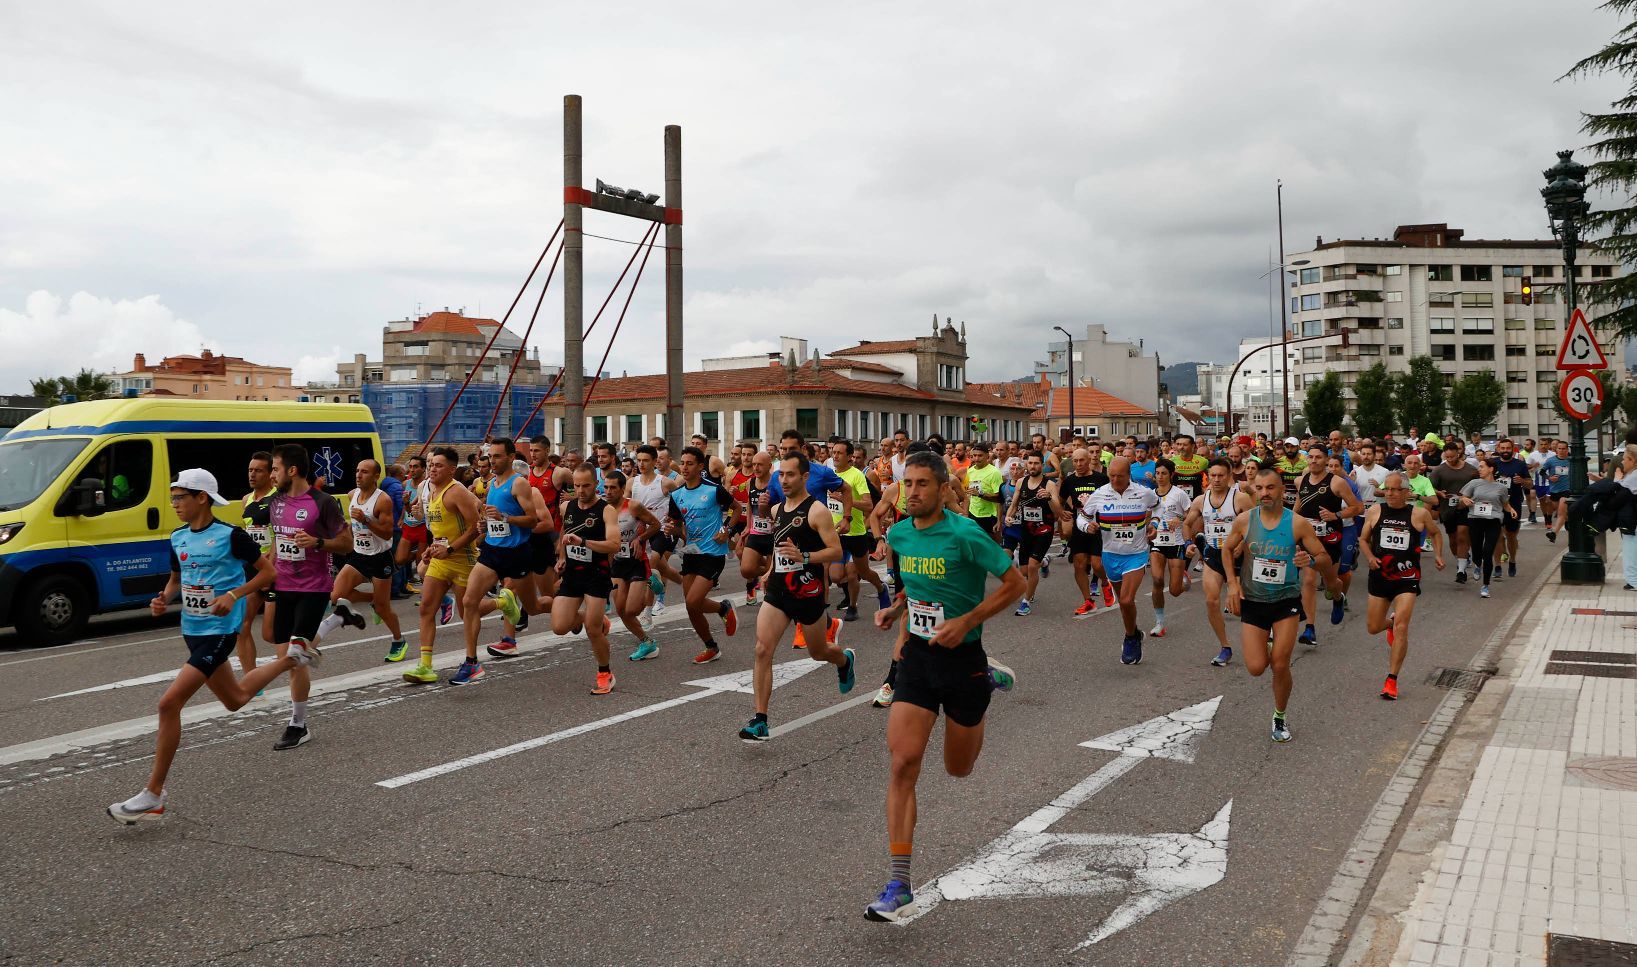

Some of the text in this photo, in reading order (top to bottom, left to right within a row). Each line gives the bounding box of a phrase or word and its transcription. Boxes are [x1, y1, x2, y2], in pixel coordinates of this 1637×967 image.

[1572, 387, 1594, 403] 30
[490, 524, 504, 532] 165
[1386, 536, 1404, 544] 301
[280, 544, 300, 554] 243
[570, 546, 586, 556] 415
[1262, 568, 1278, 578] 45
[186, 596, 208, 608] 226
[913, 612, 936, 627] 277
